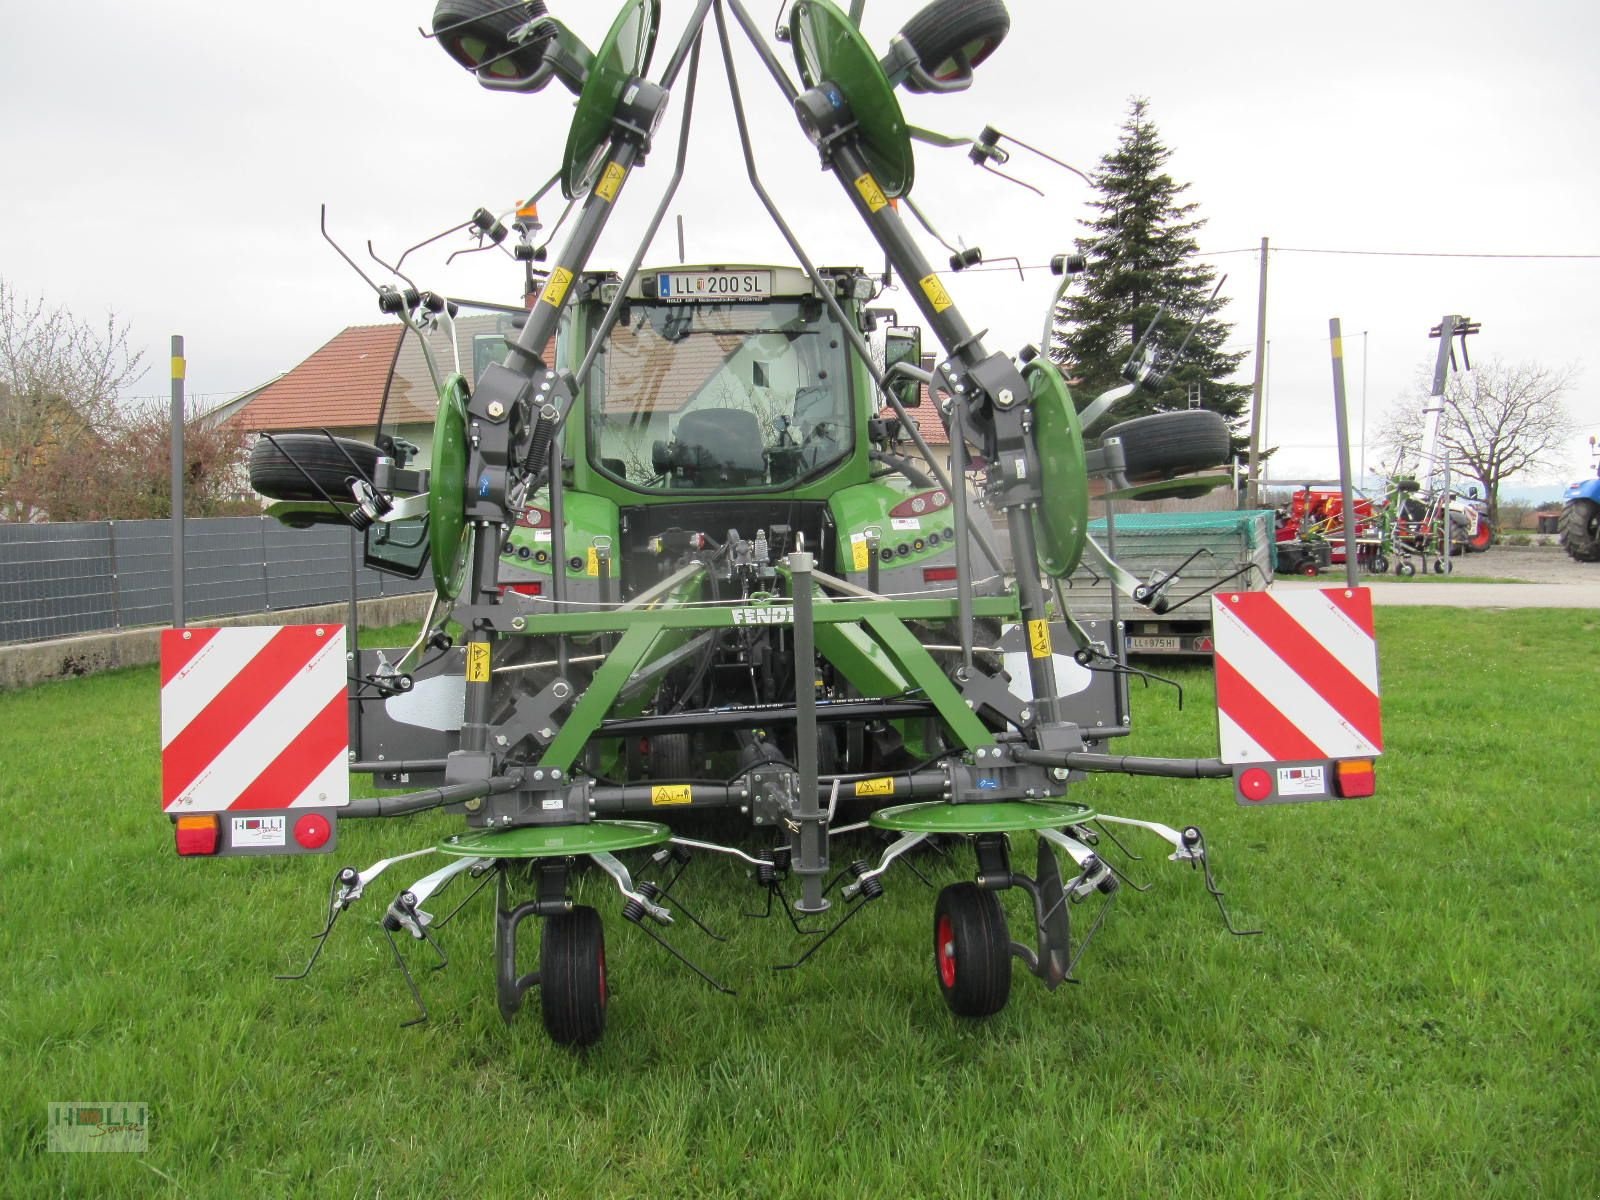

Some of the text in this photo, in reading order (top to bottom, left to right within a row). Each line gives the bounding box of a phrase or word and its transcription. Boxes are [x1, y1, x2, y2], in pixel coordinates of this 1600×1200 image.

[676, 276, 762, 294] LL 200 SL
